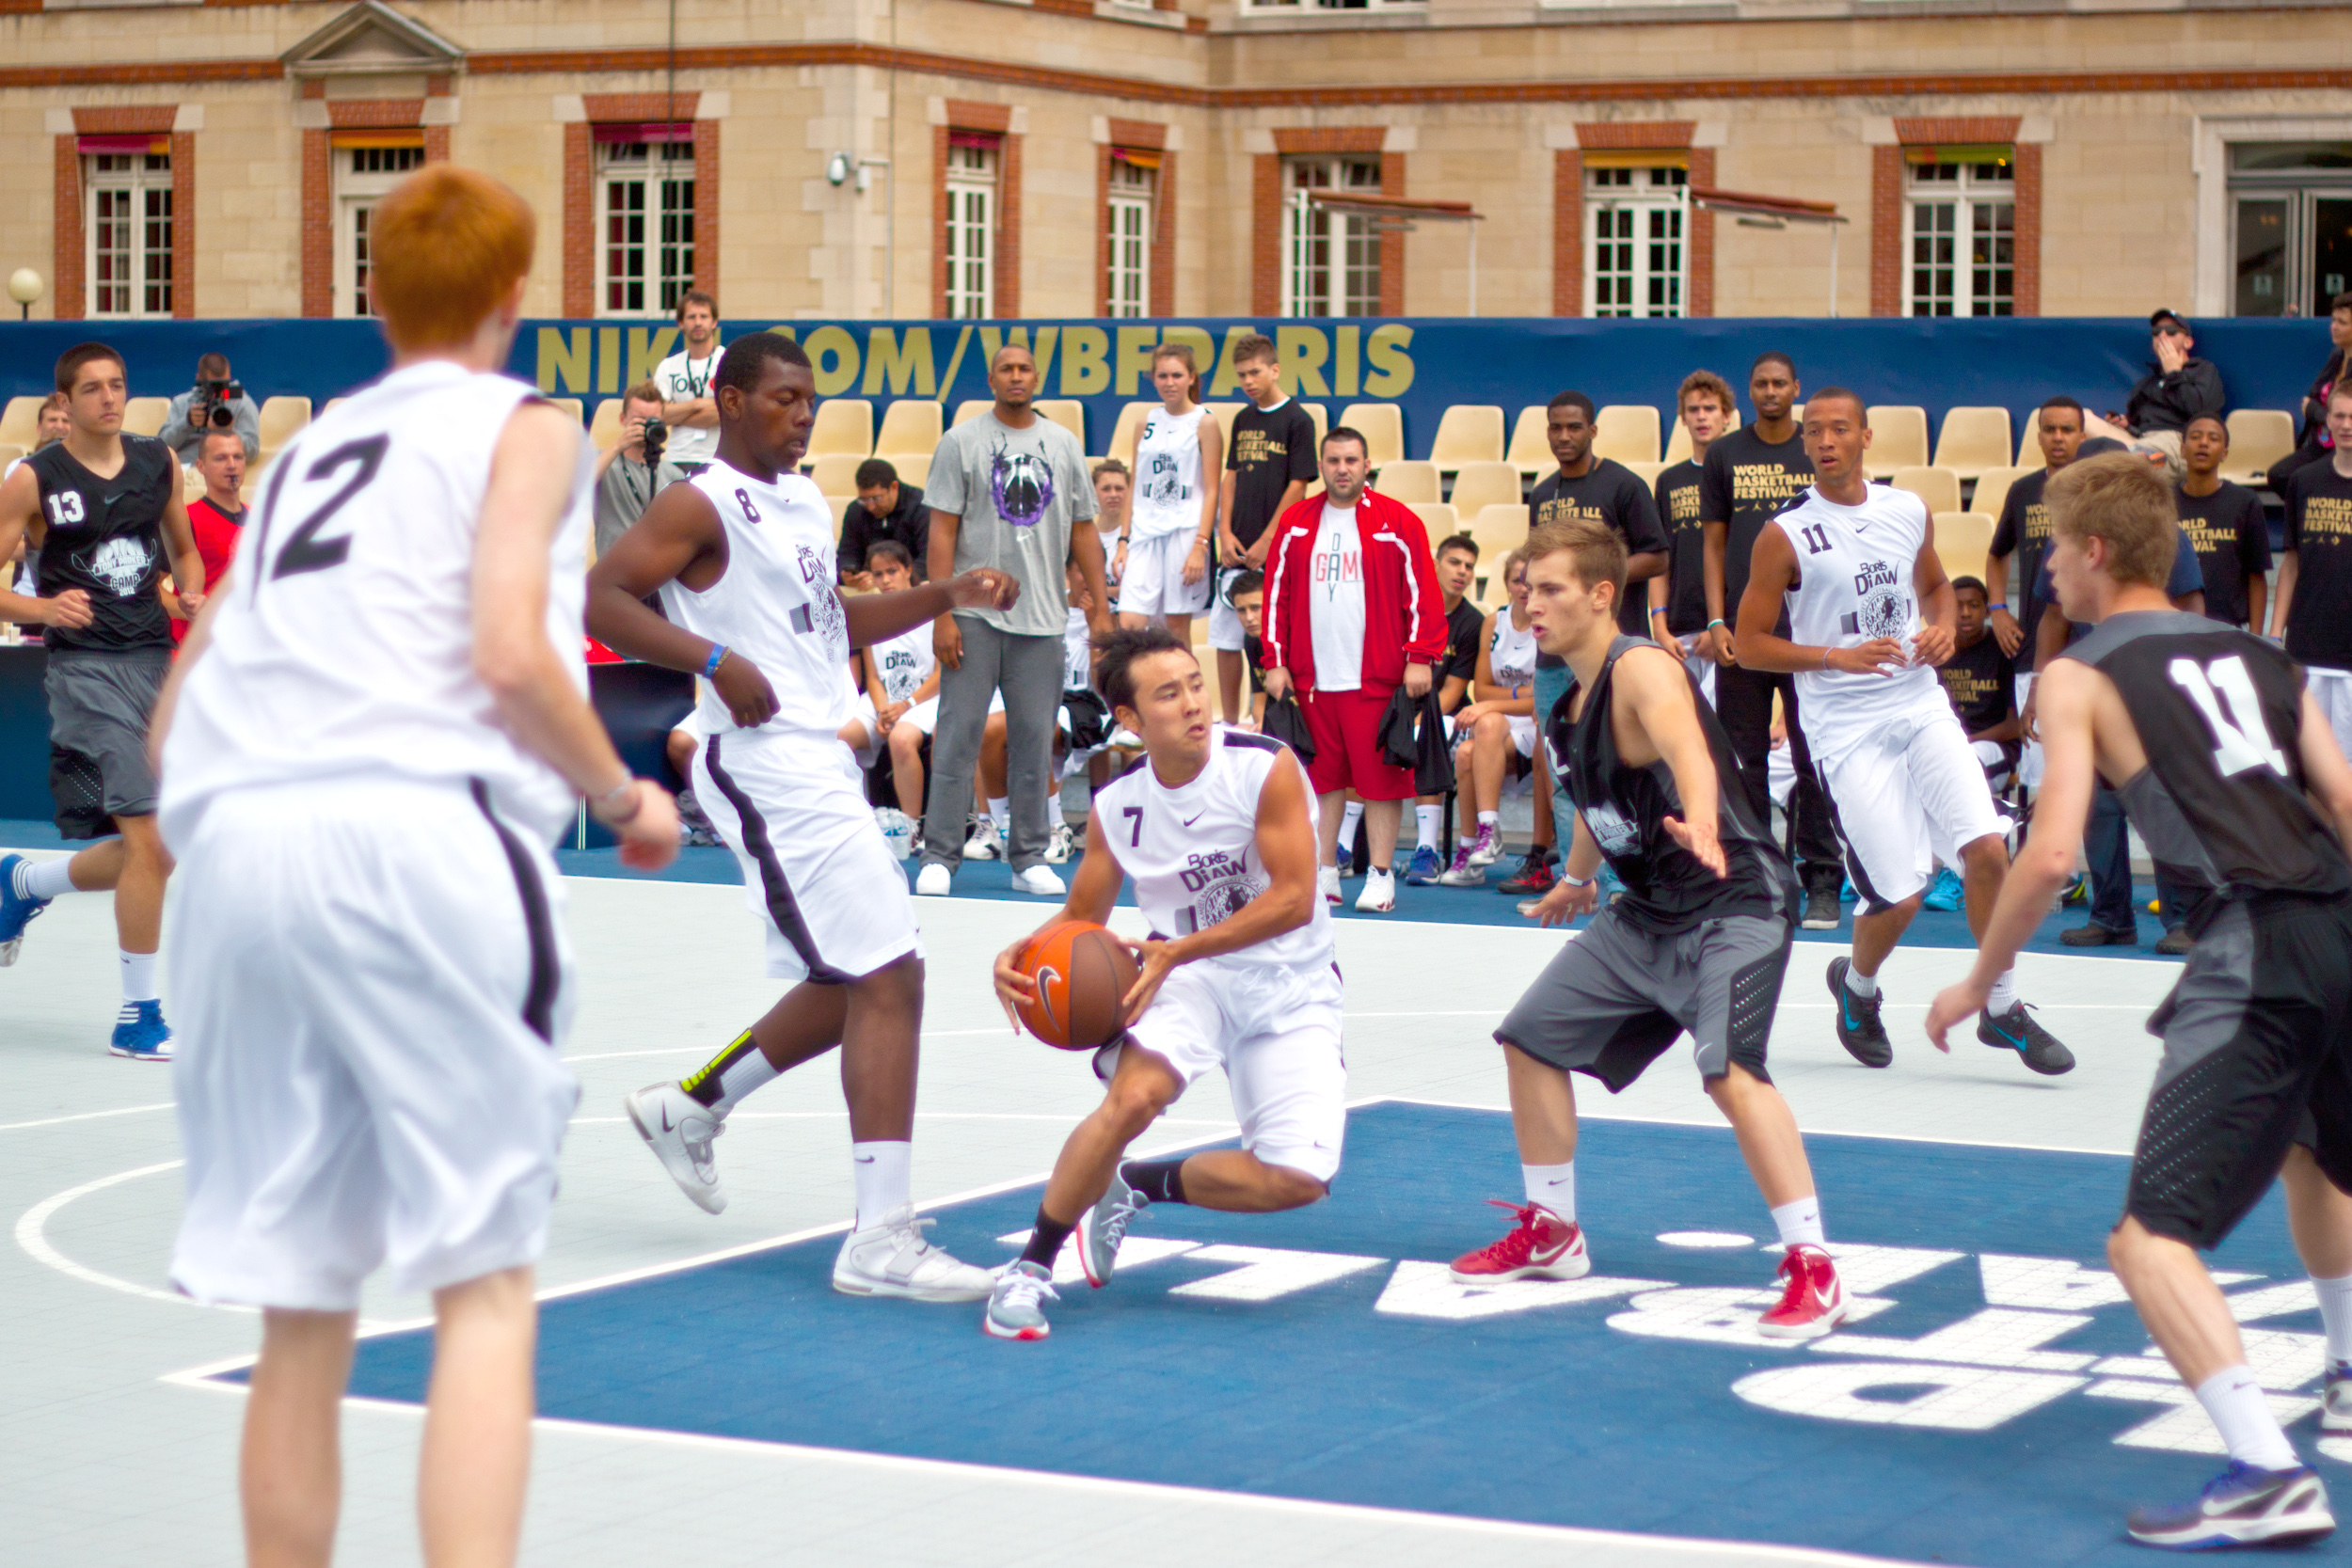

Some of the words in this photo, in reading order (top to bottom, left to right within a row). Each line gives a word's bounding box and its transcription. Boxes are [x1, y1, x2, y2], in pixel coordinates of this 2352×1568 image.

[1143, 422, 1155, 439] 5
[1733, 464, 1785, 477] WORLD
[1733, 473, 1817, 487] BASKETBALL
[1733, 485, 1796, 499] FESTIVAL
[49, 491, 85, 525] 13
[735, 488, 762, 524] 8
[2308, 497, 2352, 510] WORLD
[2305, 509, 2352, 522] BASKET
[2304, 520, 2352, 534] FESTIVA
[1802, 523, 1833, 555] 11
[111, 573, 140, 591] CAMP
[2169, 656, 2288, 778] 11
[1122, 806, 1144, 847] 7
